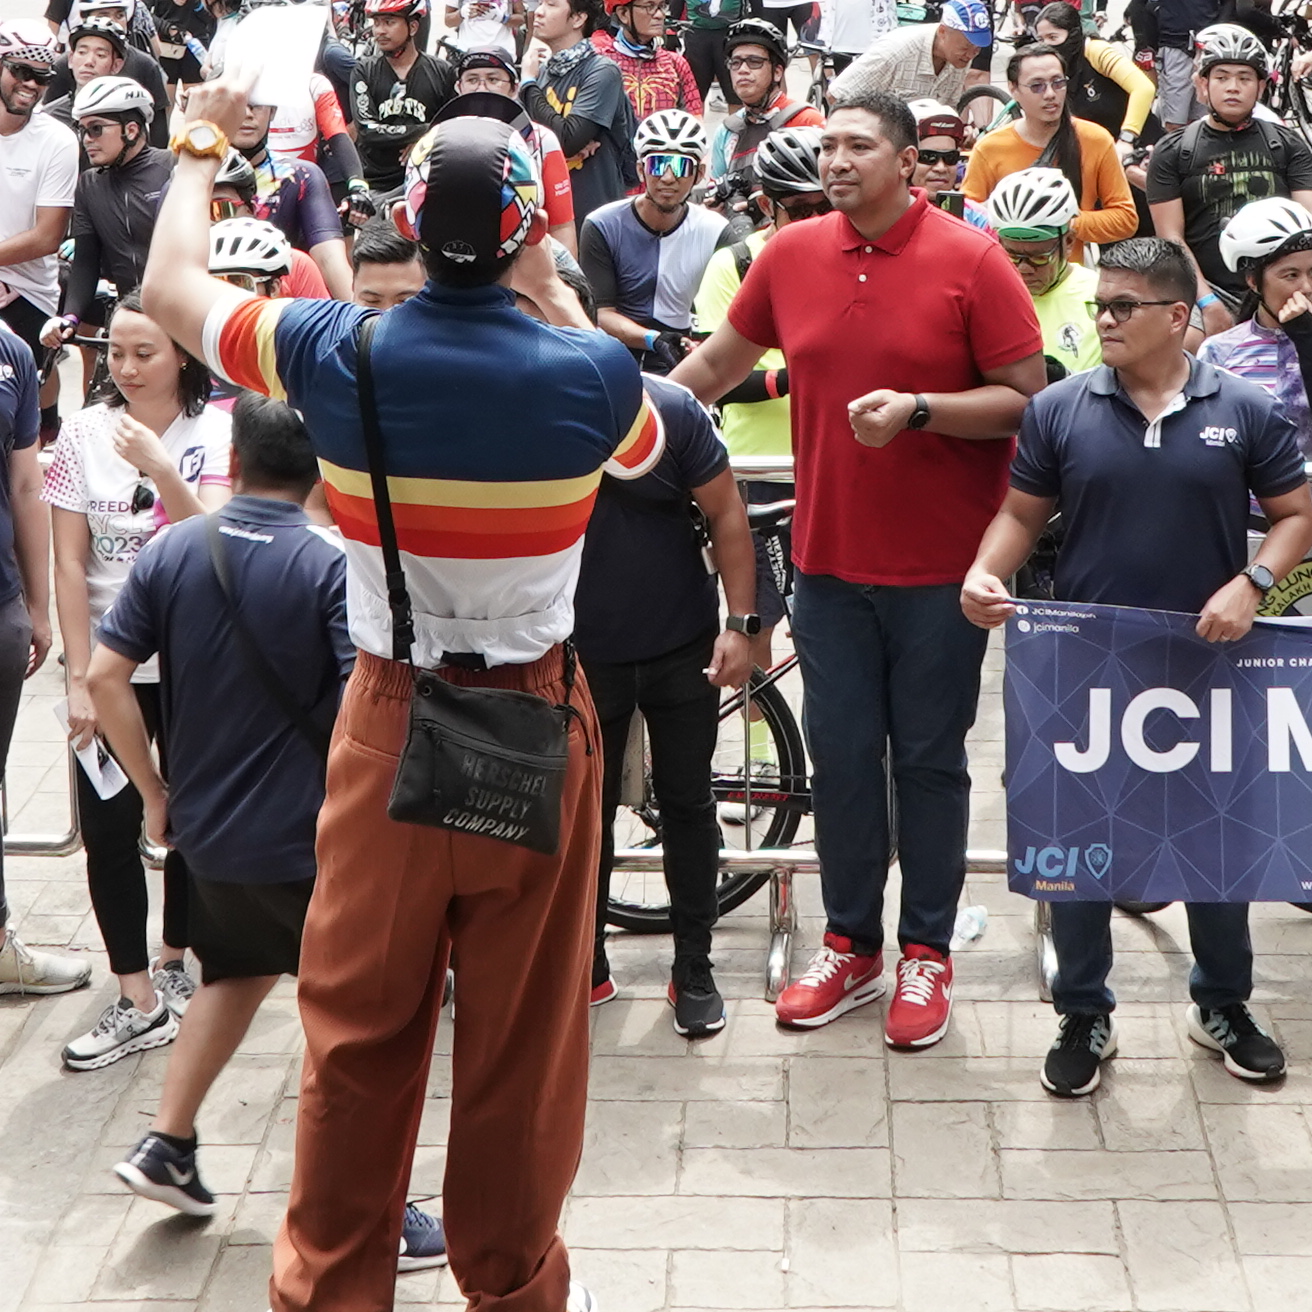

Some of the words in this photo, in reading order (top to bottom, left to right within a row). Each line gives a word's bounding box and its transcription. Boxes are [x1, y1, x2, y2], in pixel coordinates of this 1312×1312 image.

[1199, 426, 1225, 441] JCI
[1033, 622, 1080, 634] jcimanila
[1236, 658, 1285, 668] JUNIOR
[1054, 688, 1232, 774] JCI
[462, 754, 548, 798] HERSCHEL
[465, 786, 533, 820] SUPPLY
[442, 807, 531, 841] COMPANY
[1014, 846, 1080, 877] JCI
[1035, 879, 1075, 892] Manila
